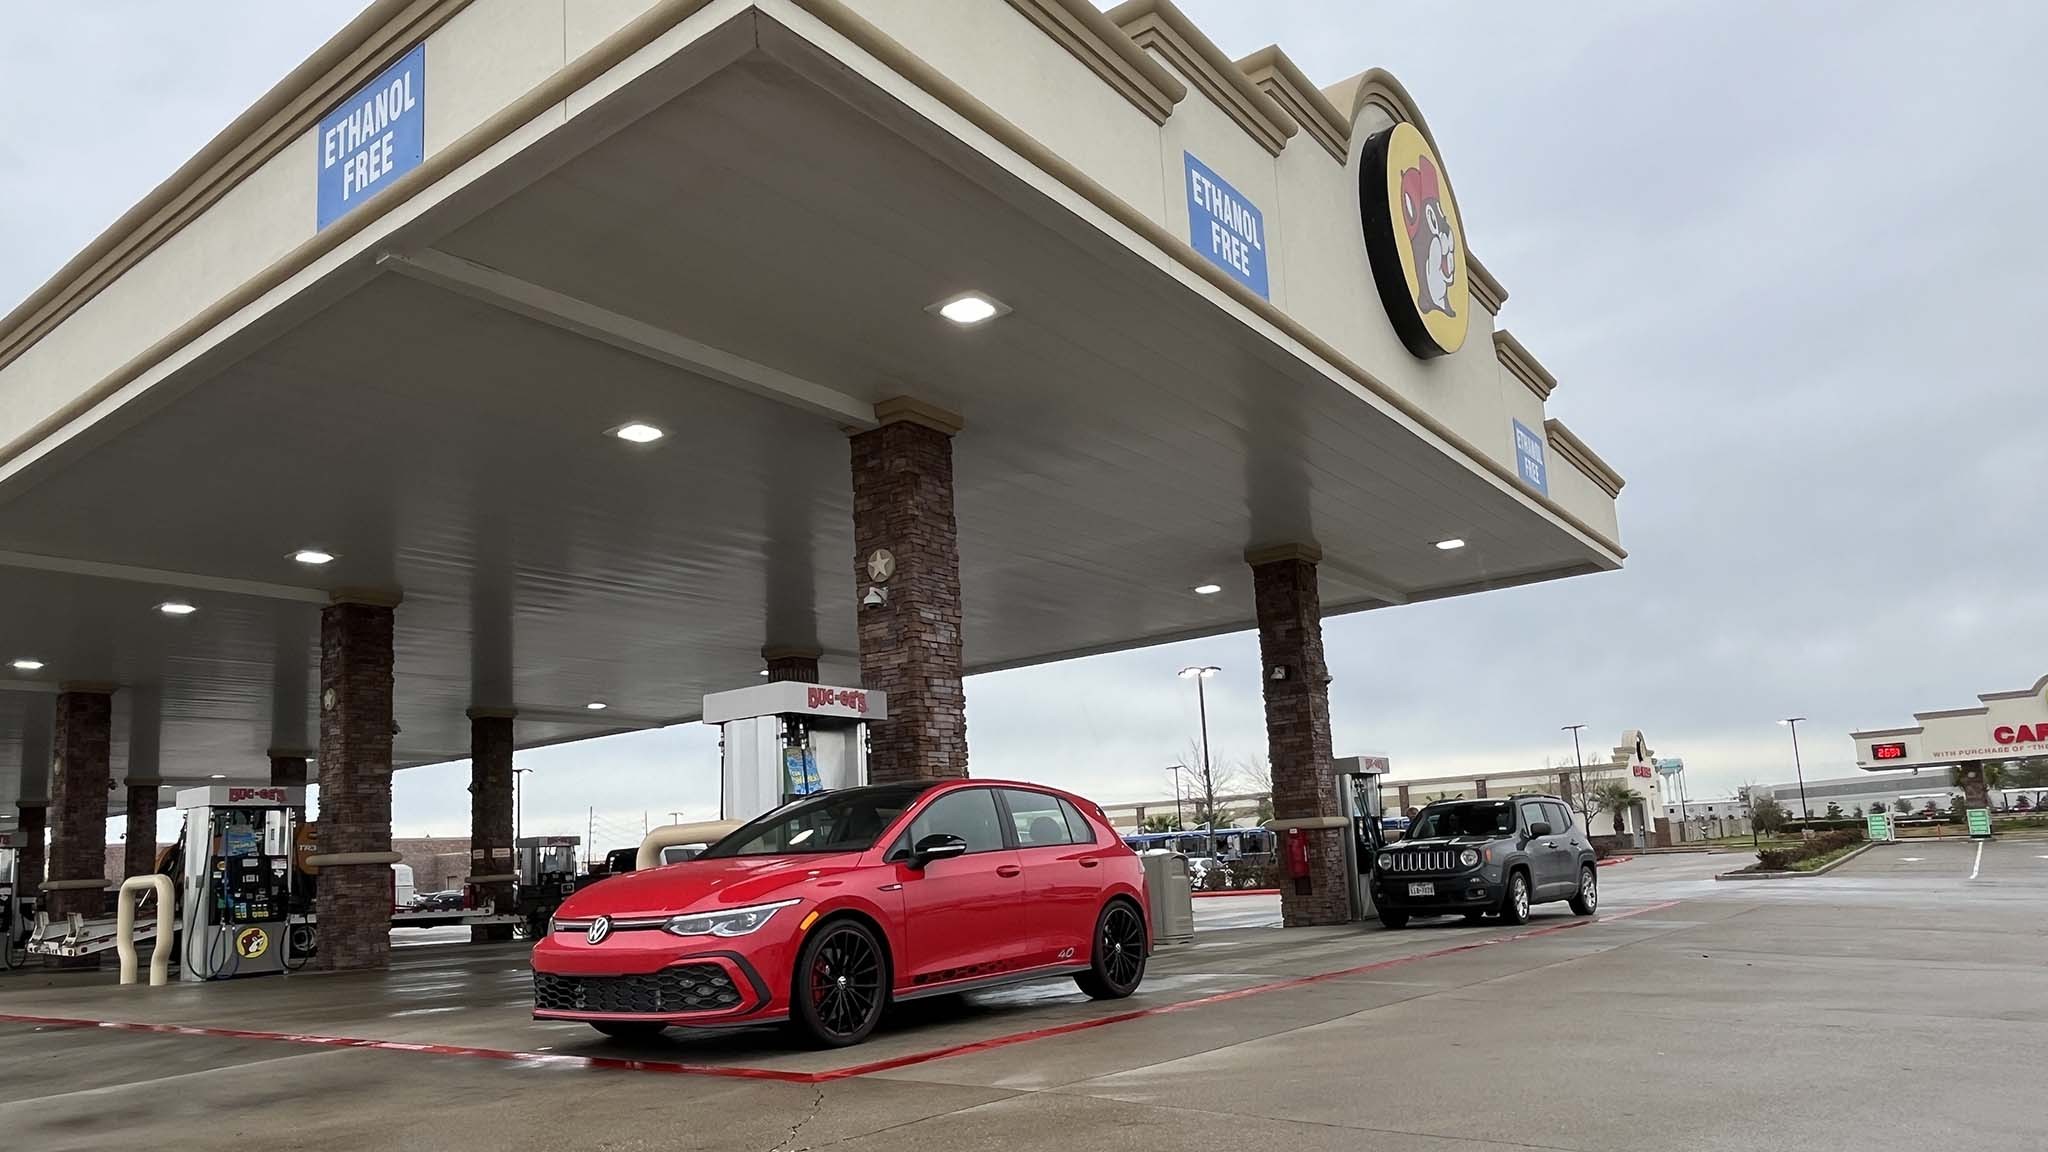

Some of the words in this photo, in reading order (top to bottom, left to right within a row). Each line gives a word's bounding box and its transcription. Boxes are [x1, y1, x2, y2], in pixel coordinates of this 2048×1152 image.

[325, 71, 415, 169] ETHANOL
[343, 131, 394, 201] FREE
[1191, 168, 1261, 250] ETHANOL
[1211, 220, 1250, 277] FREE
[1057, 947, 1074, 958] 40
